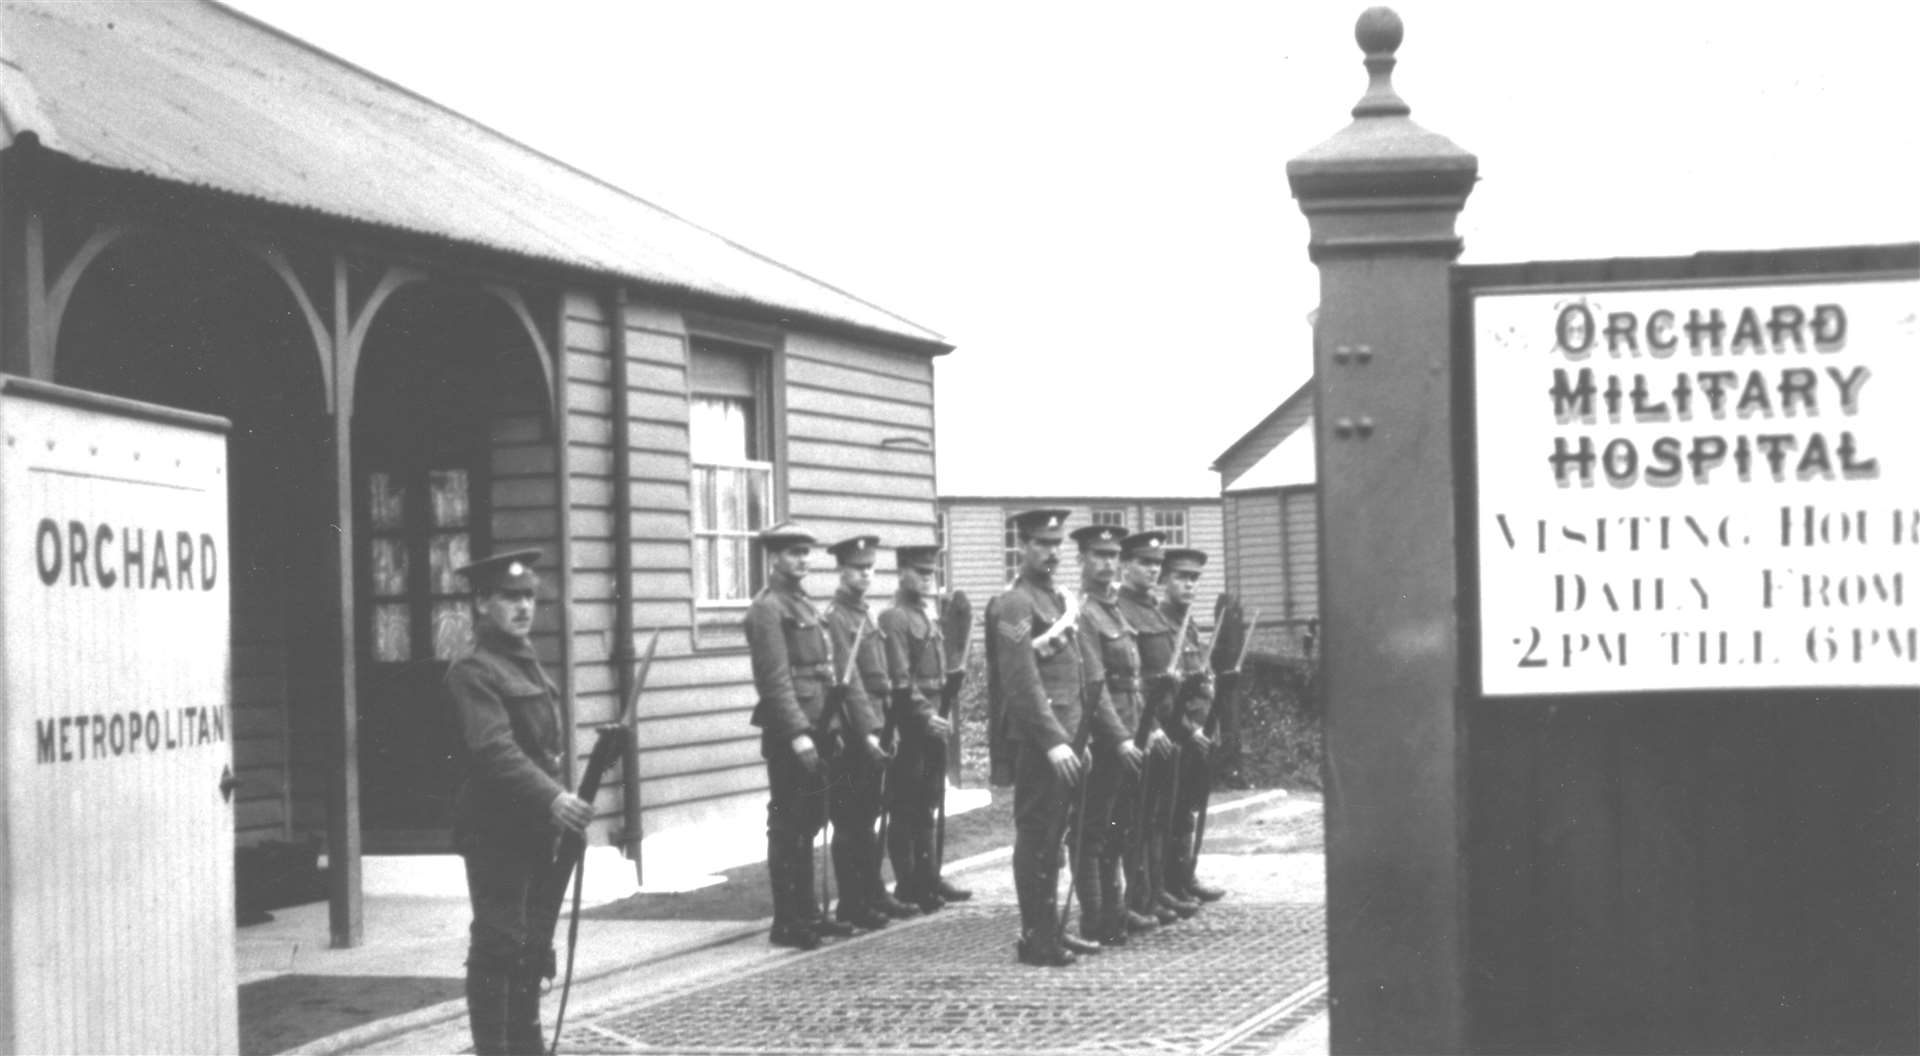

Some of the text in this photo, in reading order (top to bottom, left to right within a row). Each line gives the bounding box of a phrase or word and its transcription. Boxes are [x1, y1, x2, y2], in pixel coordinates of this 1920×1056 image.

[1551, 301, 1849, 361] ORCHARD
[1548, 365, 1872, 425] MILITARY
[1548, 431, 1881, 489] HOSPITAL
[36, 517, 217, 591] ORCHARD
[1495, 512, 1751, 554] VISITING
[1554, 568, 1904, 613] DAILY FROM
[1659, 629, 1780, 666] TILL
[36, 704, 225, 764] METROPOLITAN
